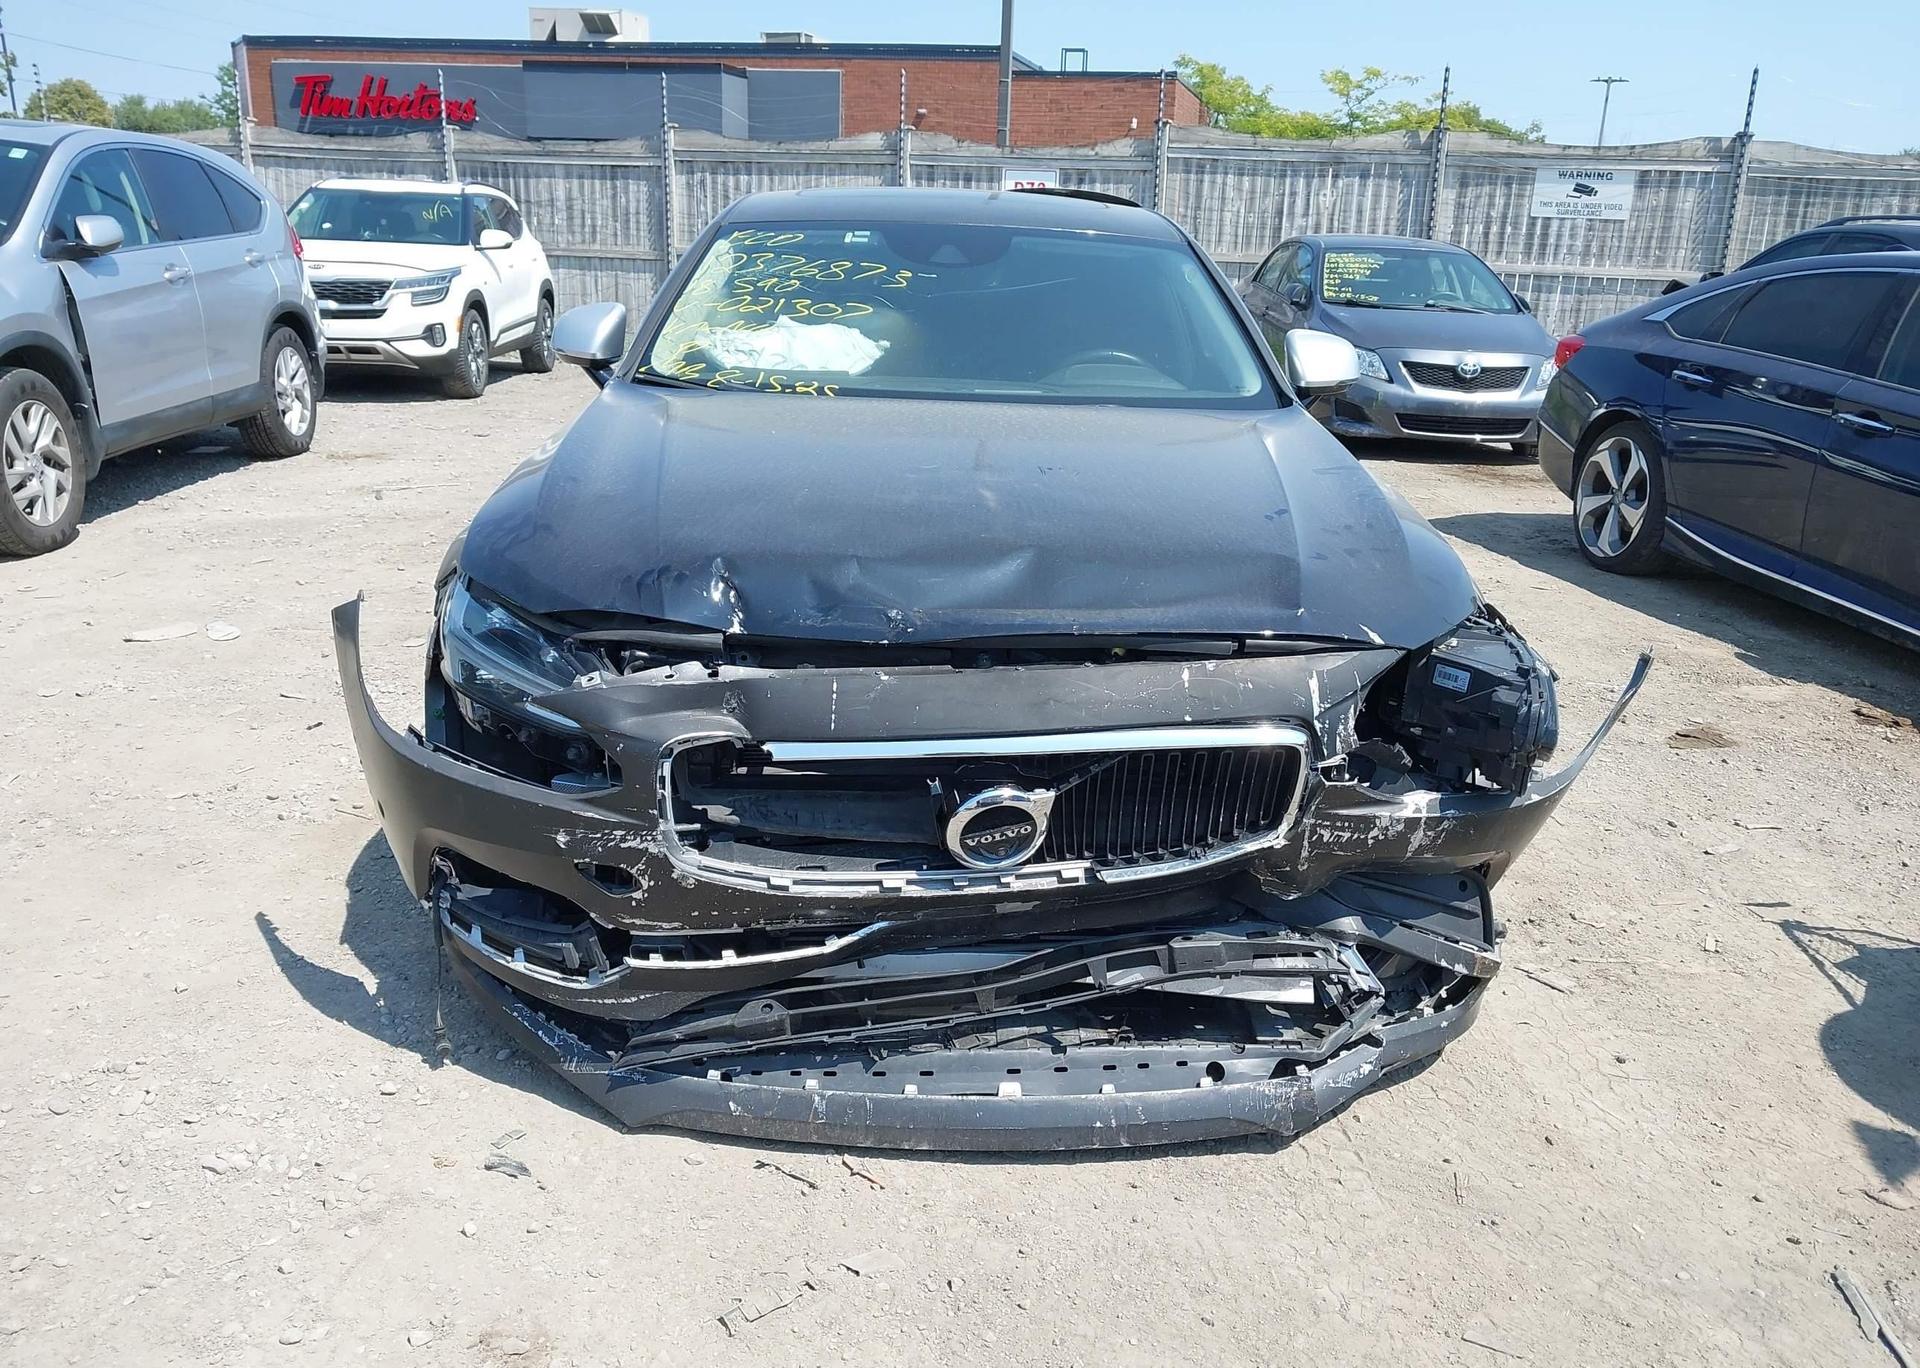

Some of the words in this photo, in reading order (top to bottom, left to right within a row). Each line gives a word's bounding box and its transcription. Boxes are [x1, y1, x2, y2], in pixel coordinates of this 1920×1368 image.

[293, 74, 352, 118] Tim
[356, 74, 477, 121] Hortons
[1558, 170, 1614, 181] WARNING
[422, 200, 454, 222] N/A
[1555, 201, 1571, 209] AREA
[1581, 202, 1602, 210] UNDER
[1604, 203, 1623, 211] VIDEO
[1556, 208, 1603, 216] SURVEILLANCE
[963, 825, 1032, 846] VOLVO
